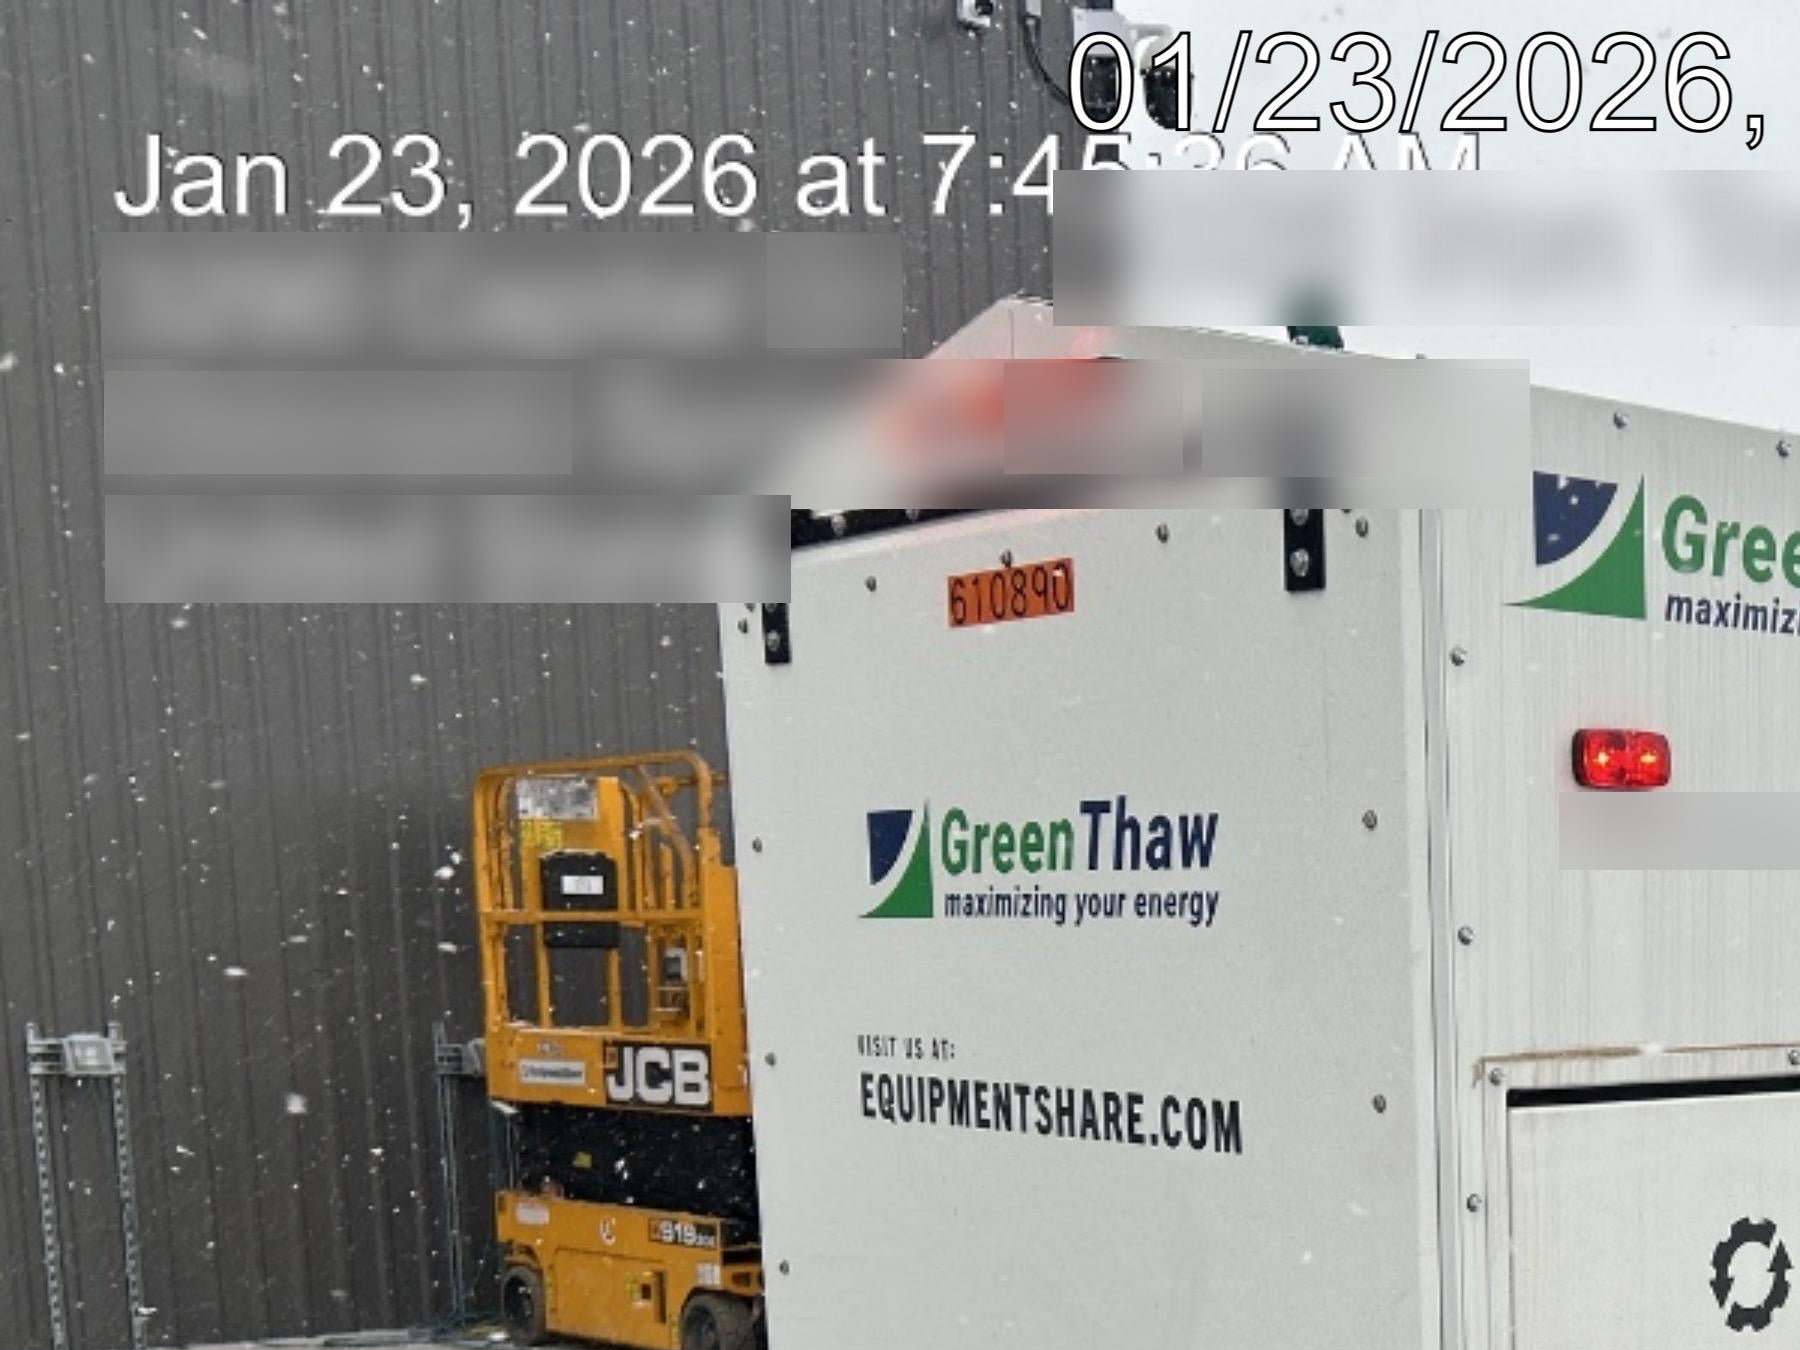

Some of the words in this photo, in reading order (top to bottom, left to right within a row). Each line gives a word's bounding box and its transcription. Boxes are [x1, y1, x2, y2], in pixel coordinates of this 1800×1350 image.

[949, 562, 1073, 627] 610890
[941, 795, 1219, 877] GreenThaw
[944, 885, 1067, 926] maximizing
[1074, 890, 1126, 926] your
[1134, 891, 1219, 928] energy
[607, 1046, 710, 1105] JCB
[857, 1034, 897, 1057] VISIT
[905, 1037, 923, 1060] US
[932, 1038, 955, 1061] AT:
[860, 1072, 1243, 1155] EQUIPMENTSHARE.COM
